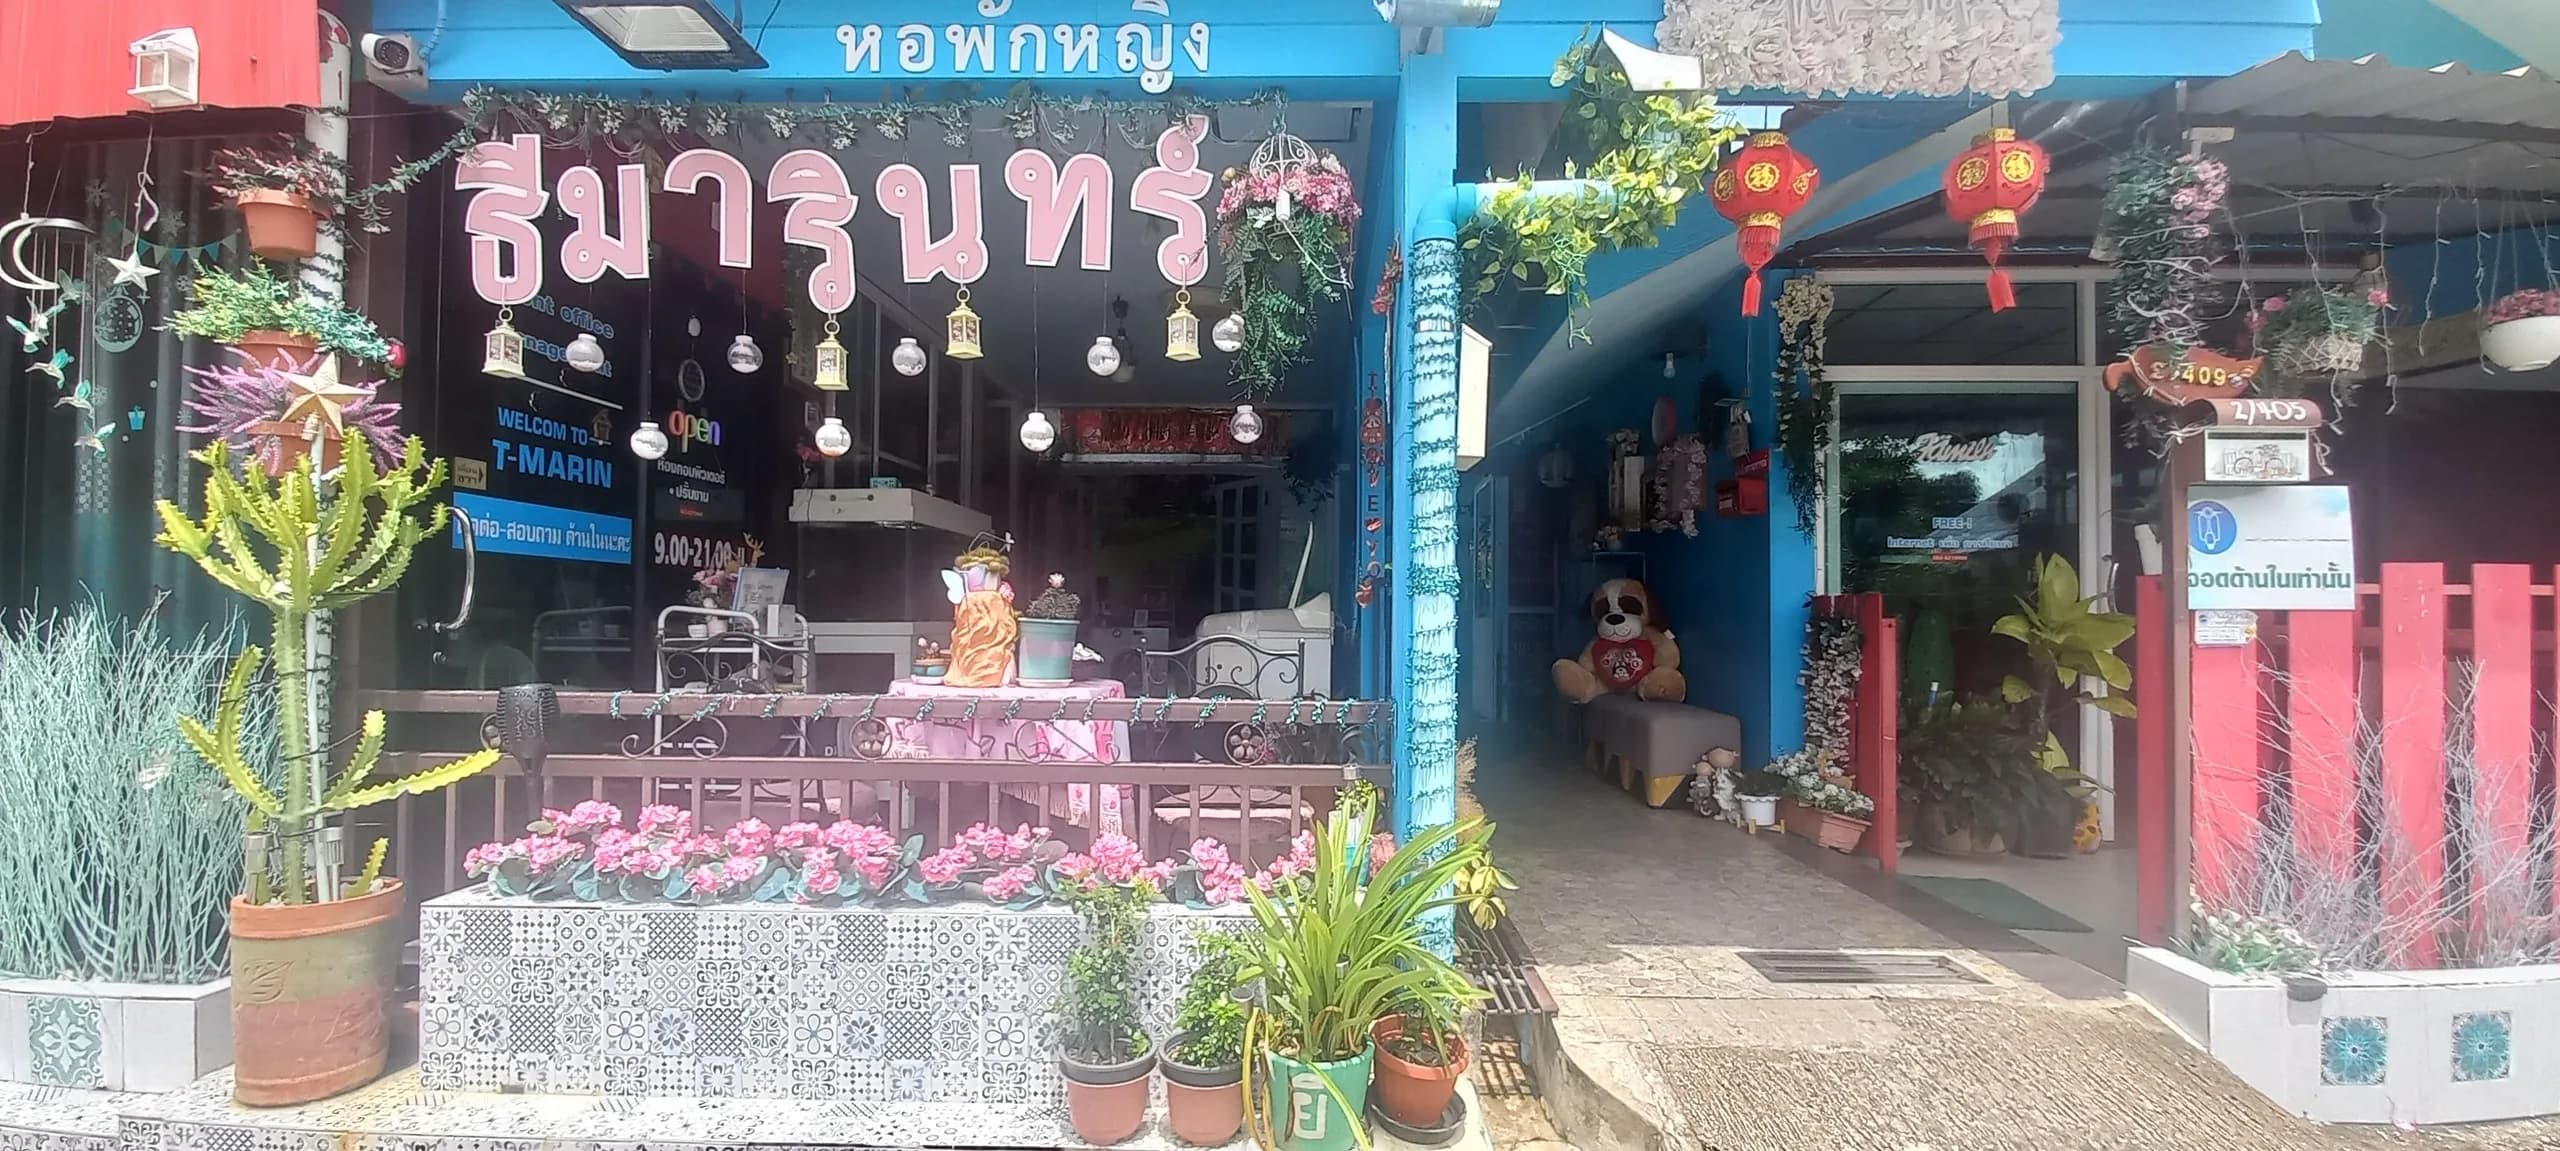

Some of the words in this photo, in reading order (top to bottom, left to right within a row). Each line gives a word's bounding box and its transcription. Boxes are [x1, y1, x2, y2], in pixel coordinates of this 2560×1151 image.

[560, 305, 615, 339] office
[497, 406, 566, 441] WELCOM
[571, 426, 588, 447] TO
[668, 408, 721, 453] open
[2230, 400, 2306, 425] 2/405
[492, 439, 613, 489] T-MARIN
[1887, 536, 1935, 548] Internet
